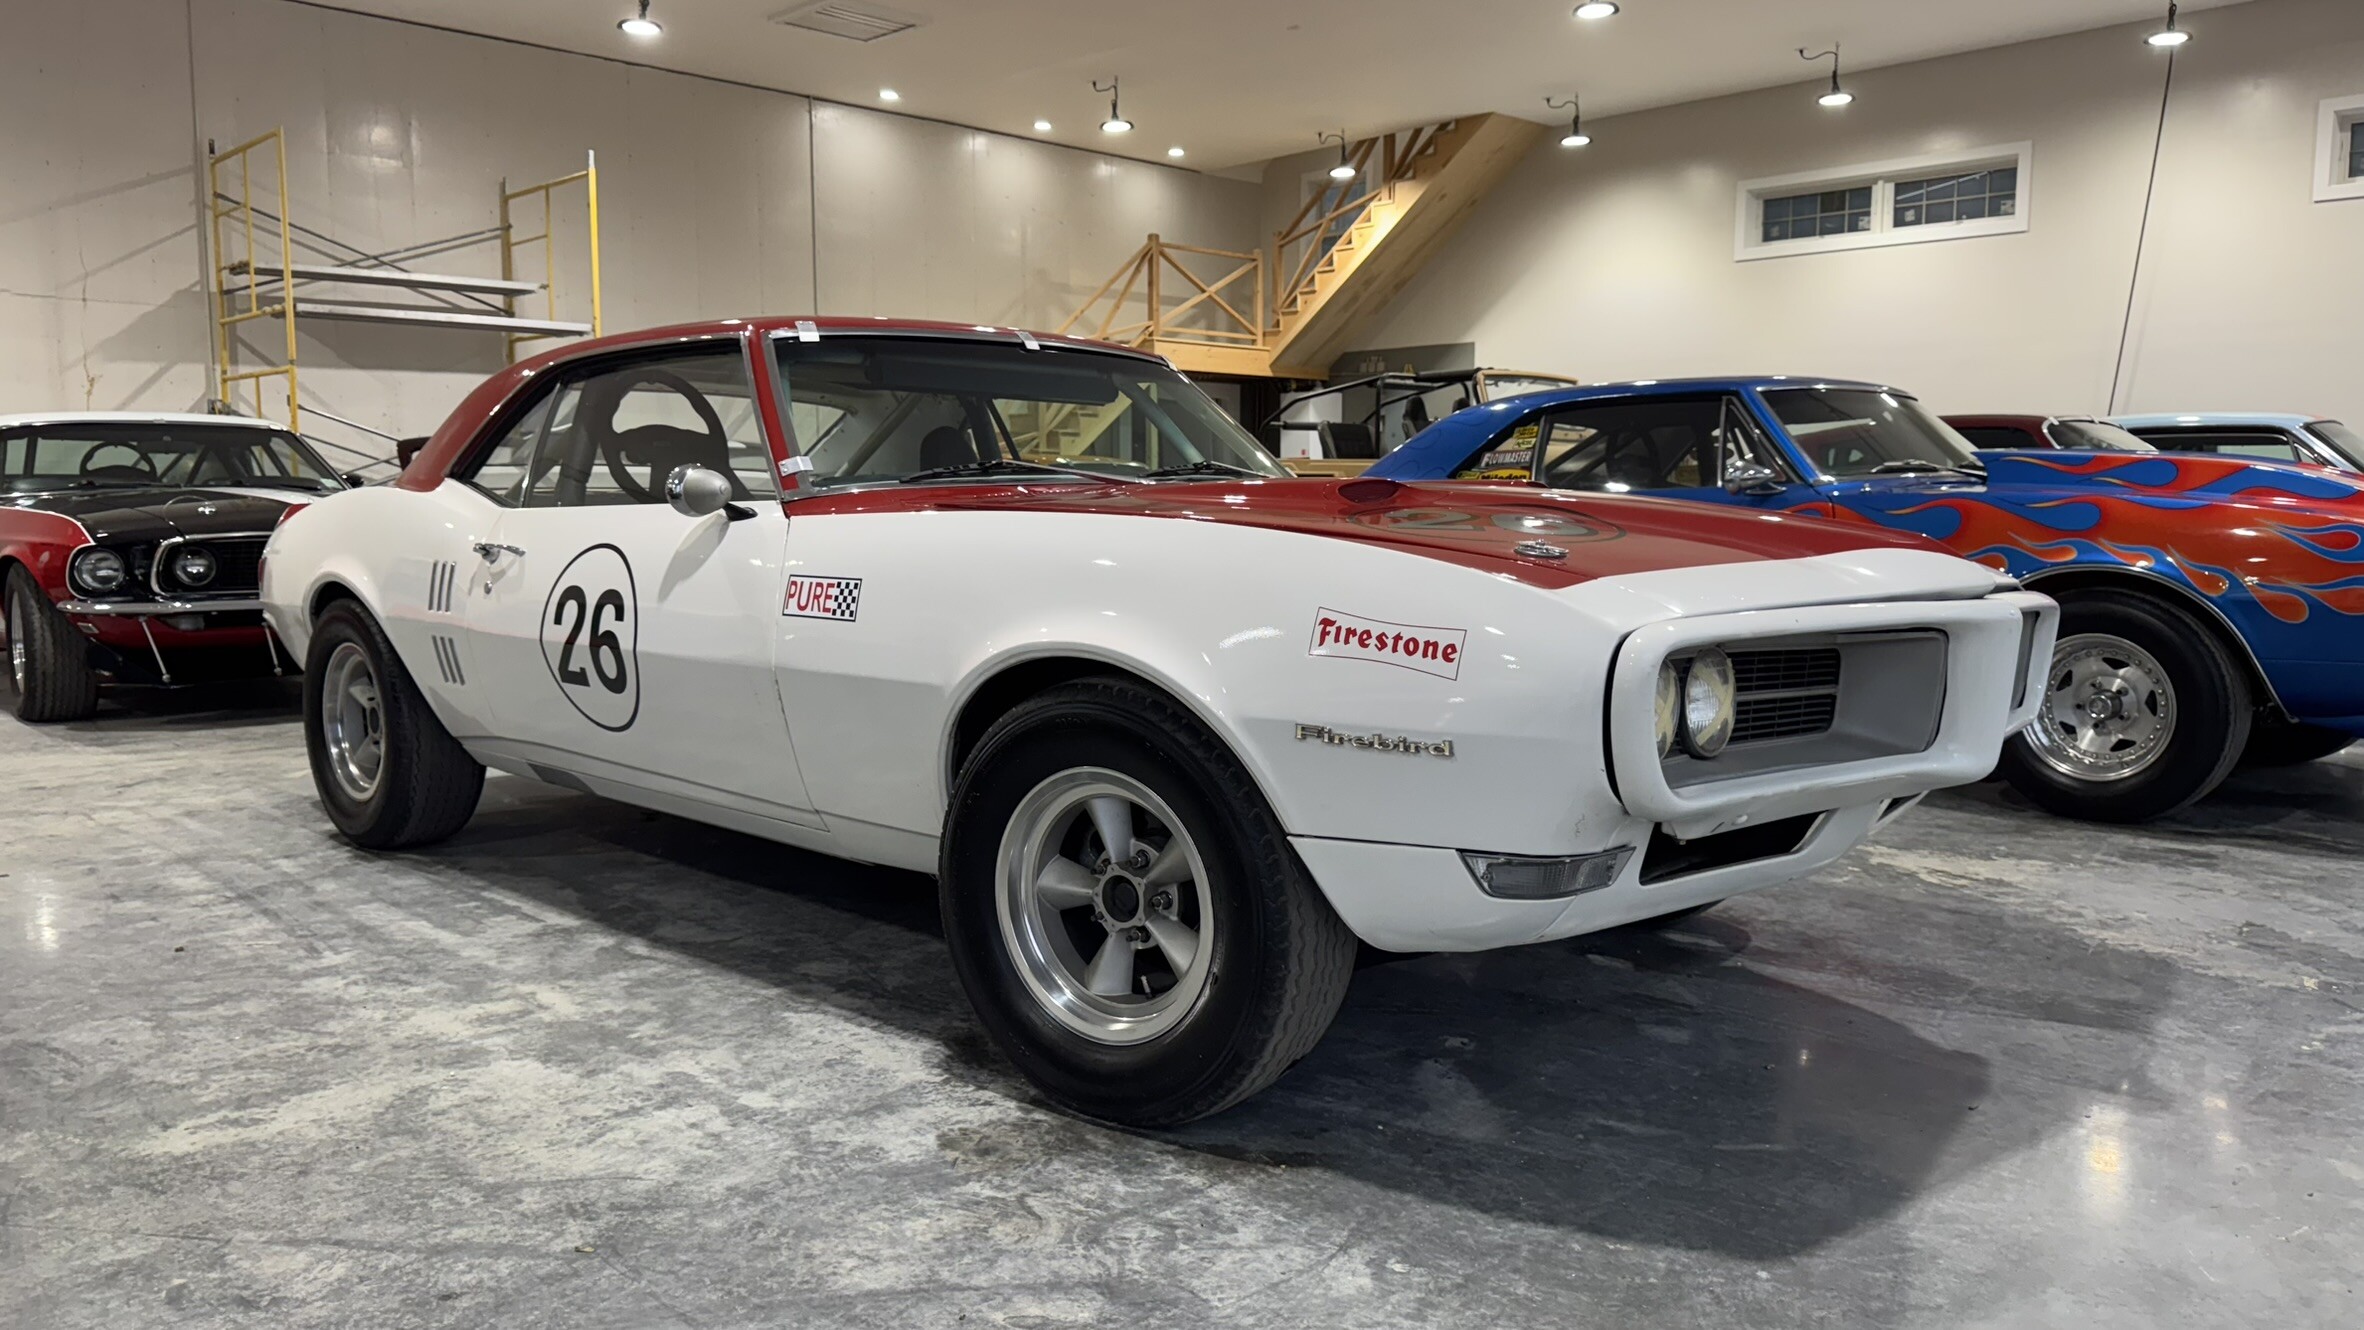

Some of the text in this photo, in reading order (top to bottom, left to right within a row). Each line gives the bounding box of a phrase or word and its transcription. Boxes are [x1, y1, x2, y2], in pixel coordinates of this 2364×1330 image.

[1481, 451, 1532, 467] FLOWMASTER
[785, 580, 835, 613] PURE
[554, 585, 627, 694] 26
[1318, 617, 1458, 664] Firestone
[1295, 723, 1454, 758] Firebird
